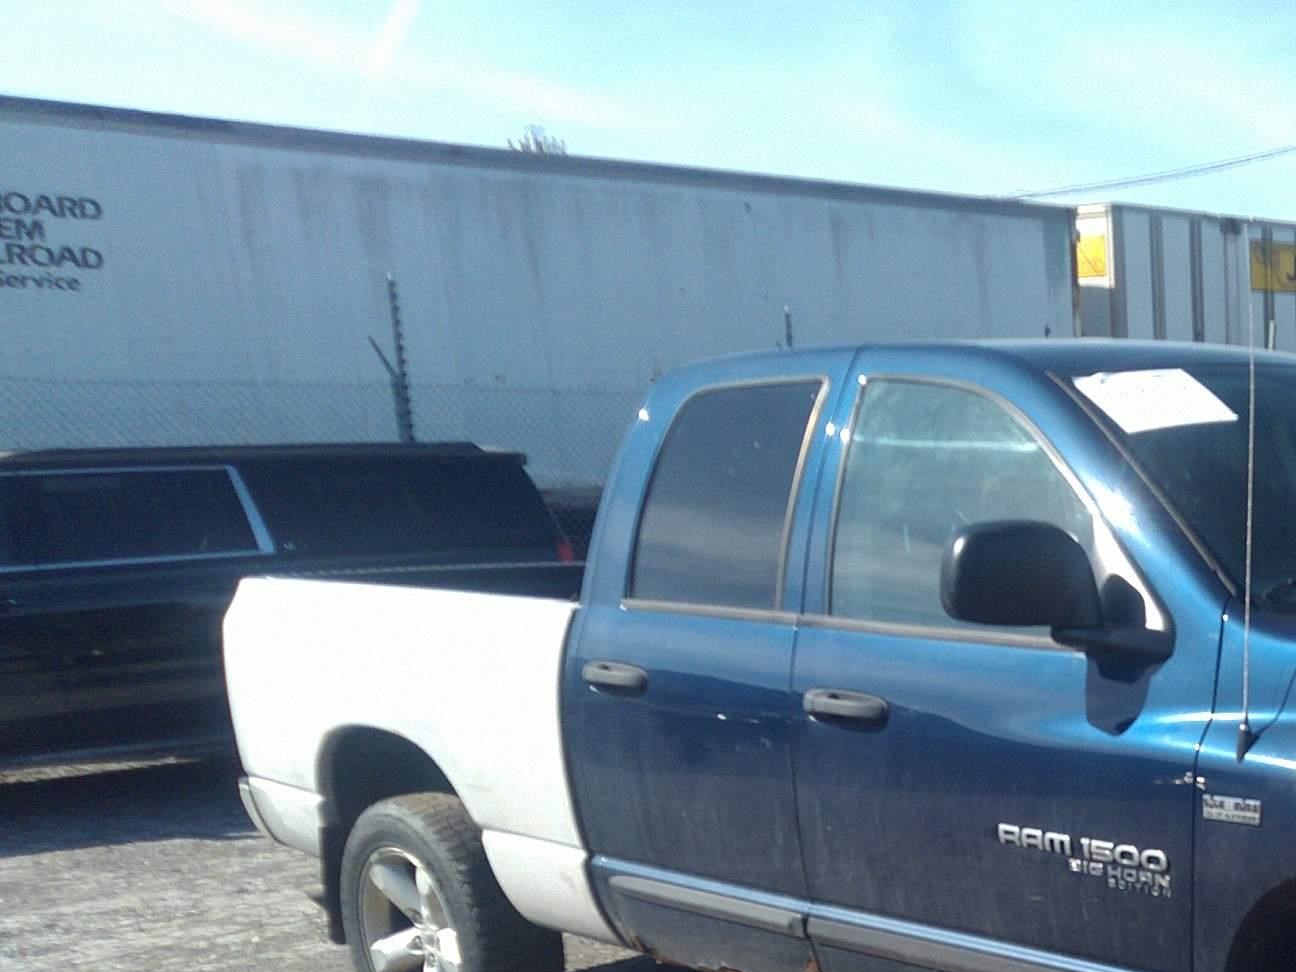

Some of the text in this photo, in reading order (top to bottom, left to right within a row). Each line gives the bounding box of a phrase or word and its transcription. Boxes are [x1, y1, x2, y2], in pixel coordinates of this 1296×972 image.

[0, 191, 103, 220] OARD
[997, 822, 1168, 873] RAM 1500
[1106, 865, 1171, 889] HORN
[1107, 877, 1171, 898] EDITION
